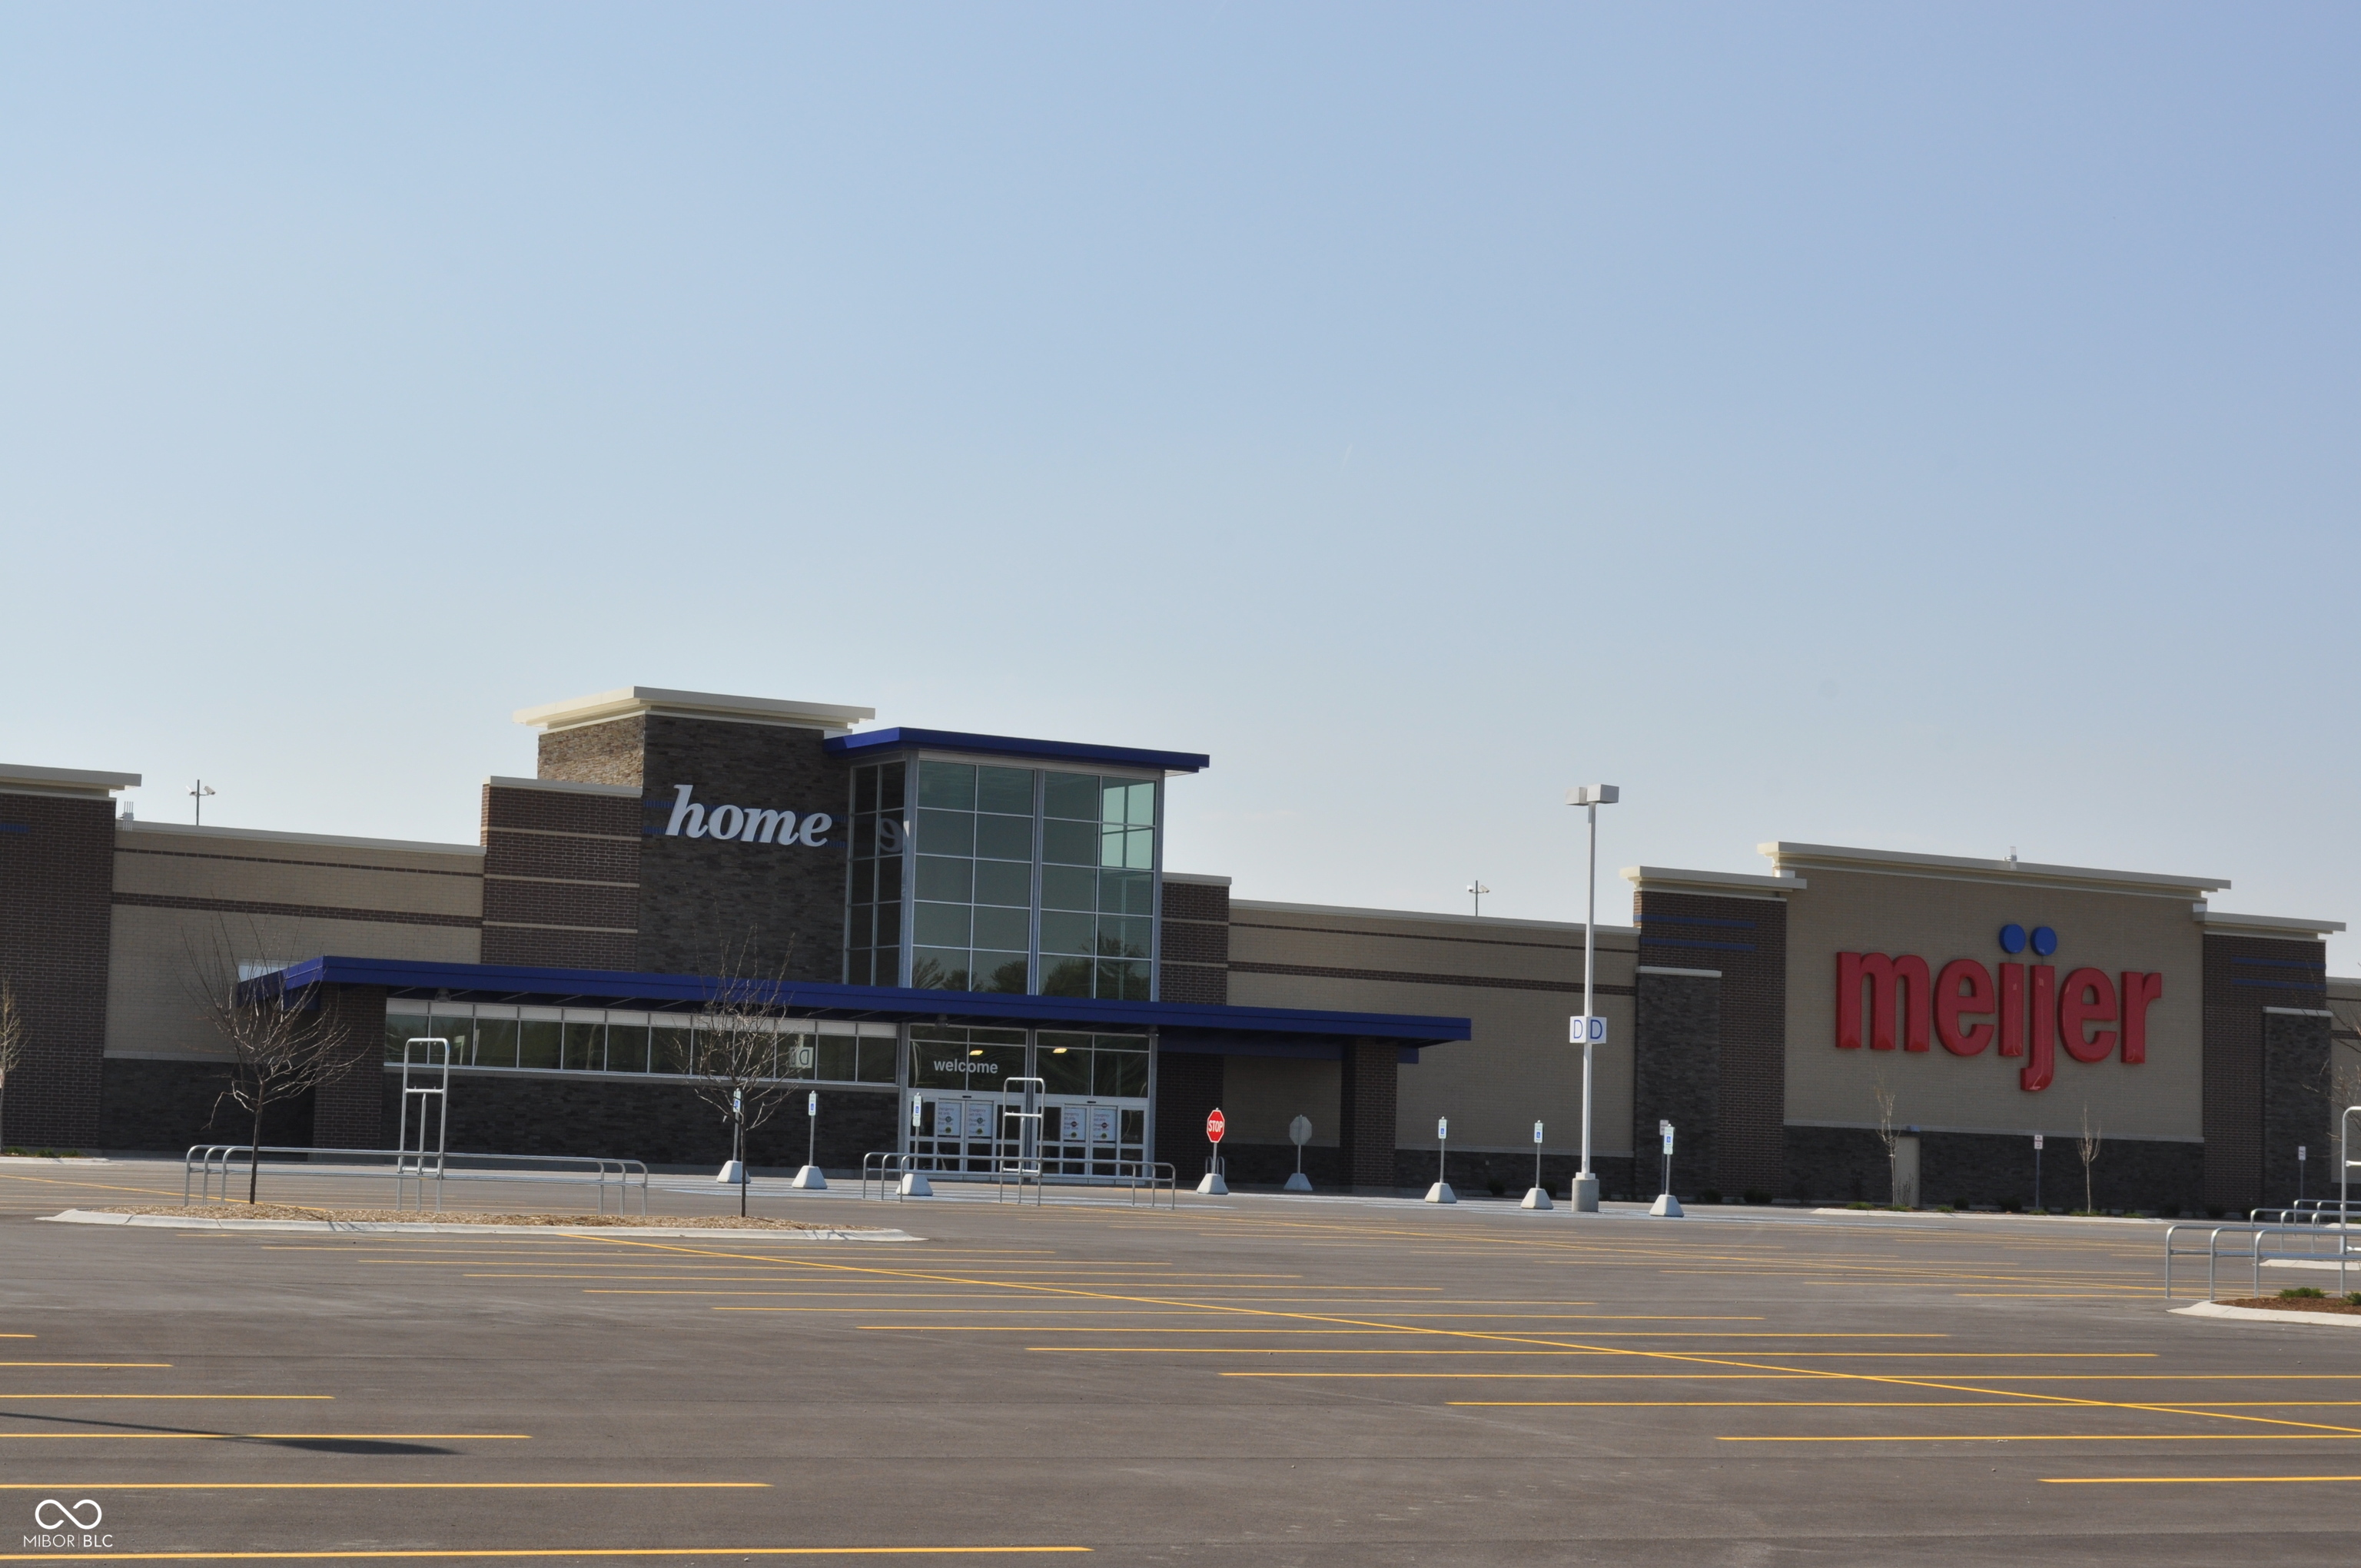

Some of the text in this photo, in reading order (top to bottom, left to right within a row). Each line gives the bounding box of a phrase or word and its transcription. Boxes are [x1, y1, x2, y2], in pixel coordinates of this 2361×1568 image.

[665, 784, 832, 847] home
[1835, 924, 2162, 1091] meijer
[1573, 1019, 1583, 1039] D
[1590, 1018, 1603, 1040] D
[934, 1058, 998, 1074] welcome
[1208, 1120, 1224, 1133] STOP
